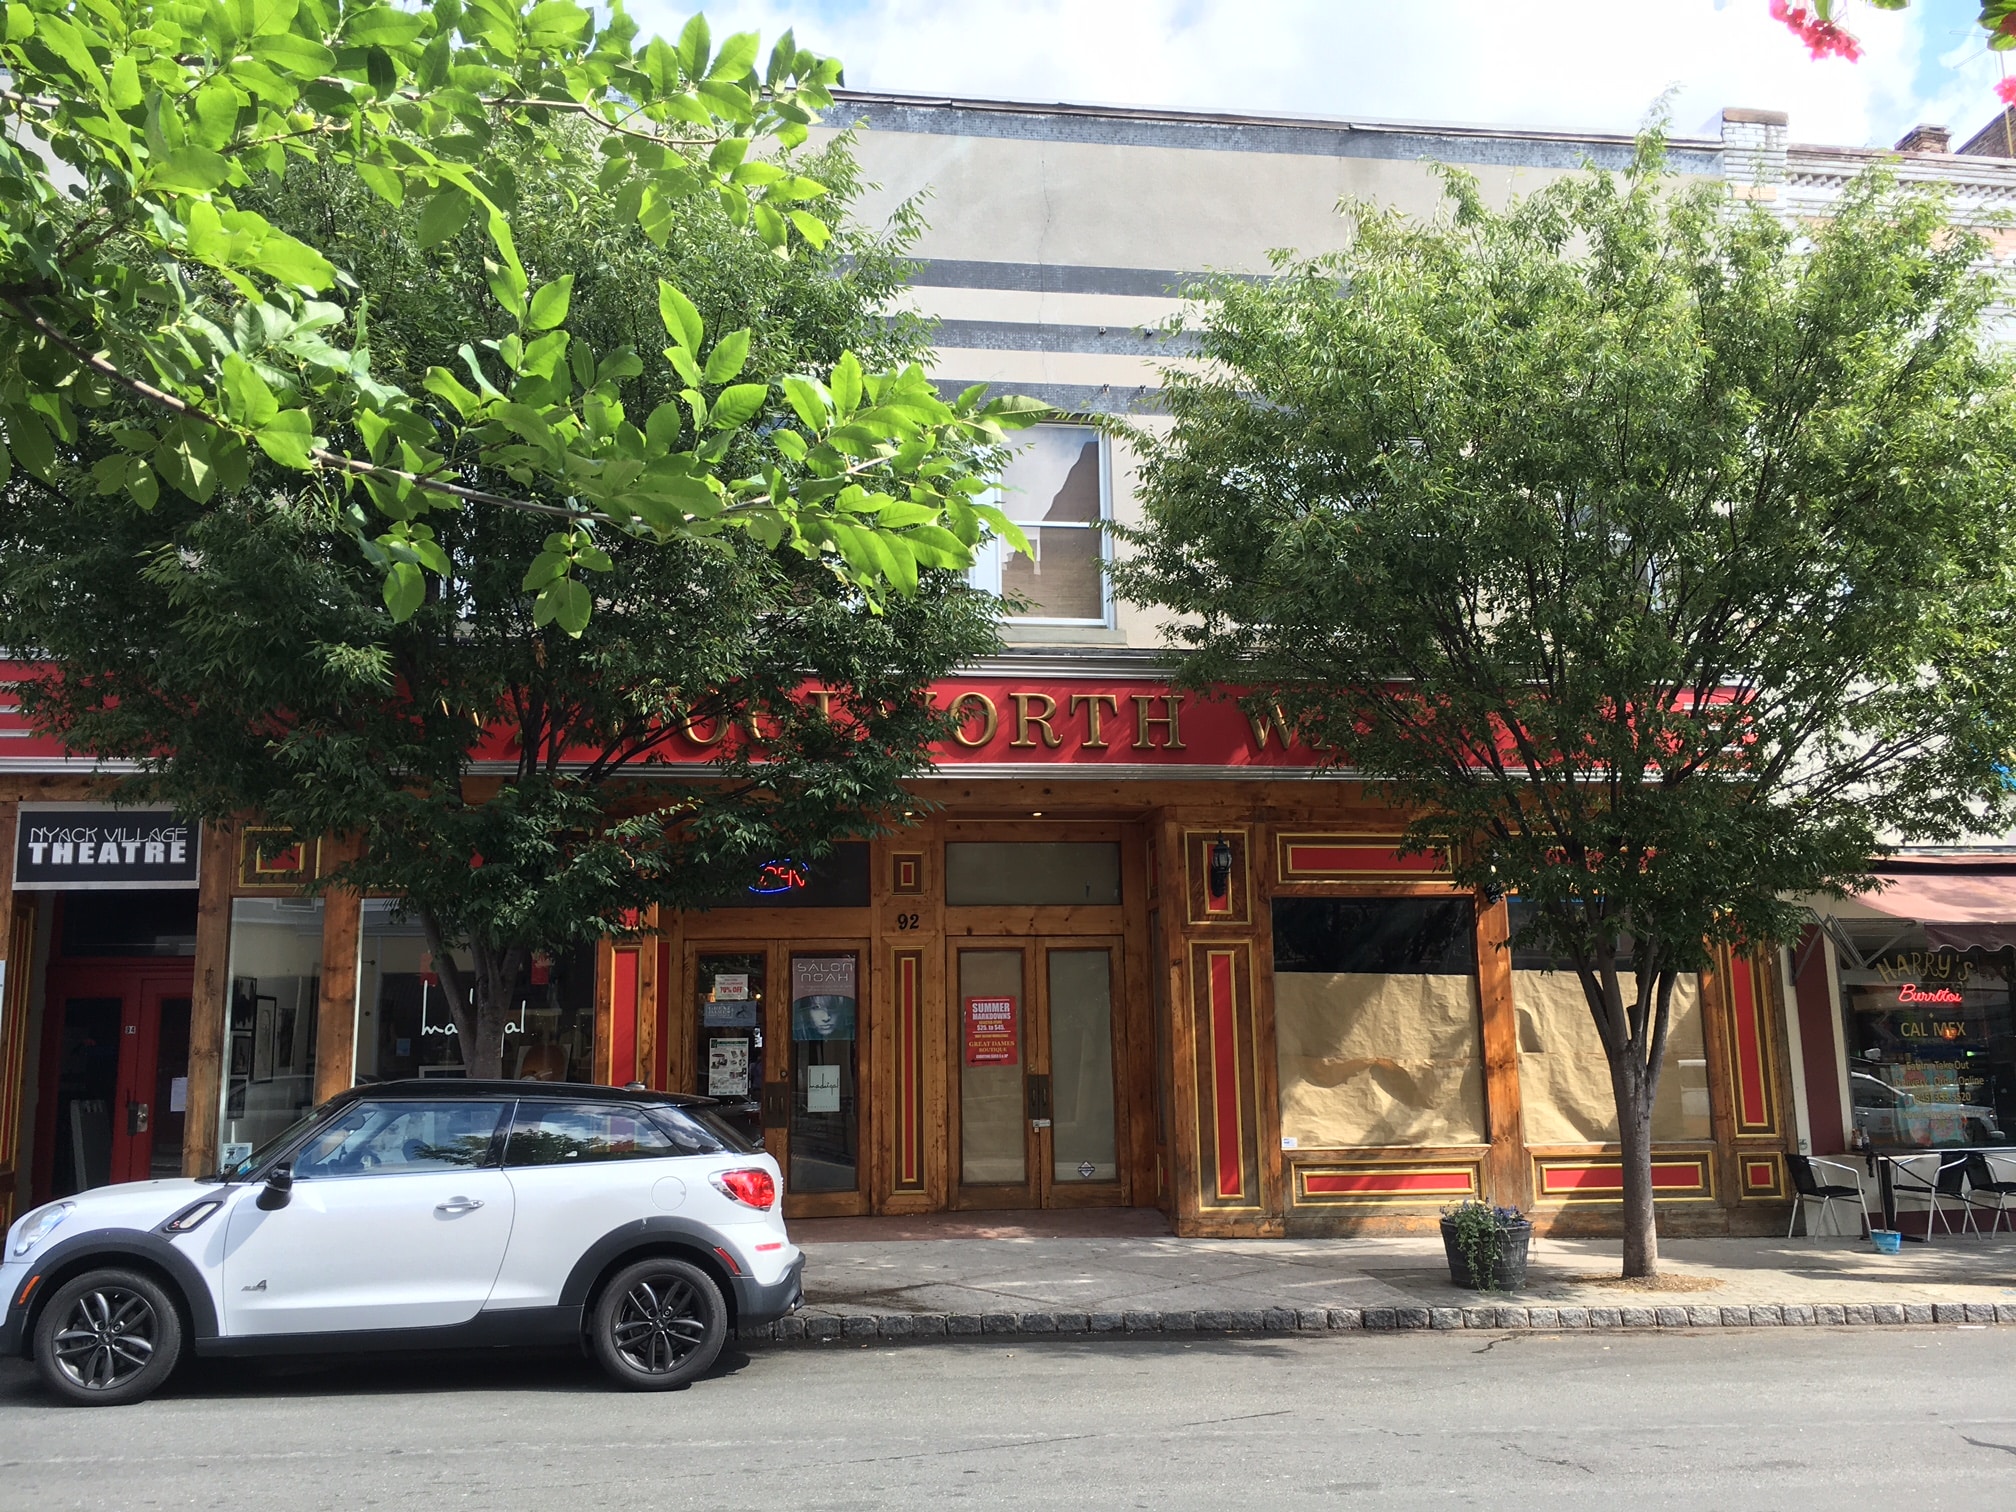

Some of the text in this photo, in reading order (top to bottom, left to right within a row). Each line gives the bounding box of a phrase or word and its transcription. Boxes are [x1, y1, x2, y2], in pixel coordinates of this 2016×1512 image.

[30, 826, 188, 843] NYACK VILLAGE
[28, 842, 187, 865] THEATRE
[897, 913, 920, 930] 92
[797, 960, 853, 972] SALON
[801, 973, 849, 982] NOAH
[1898, 983, 1963, 1002] Burritos
[972, 1002, 1010, 1013] SUMMER
[1901, 1022, 1966, 1037] CAL MEX
[1954, 1060, 1970, 1070] Out
[1958, 1076, 1985, 1087] Online
